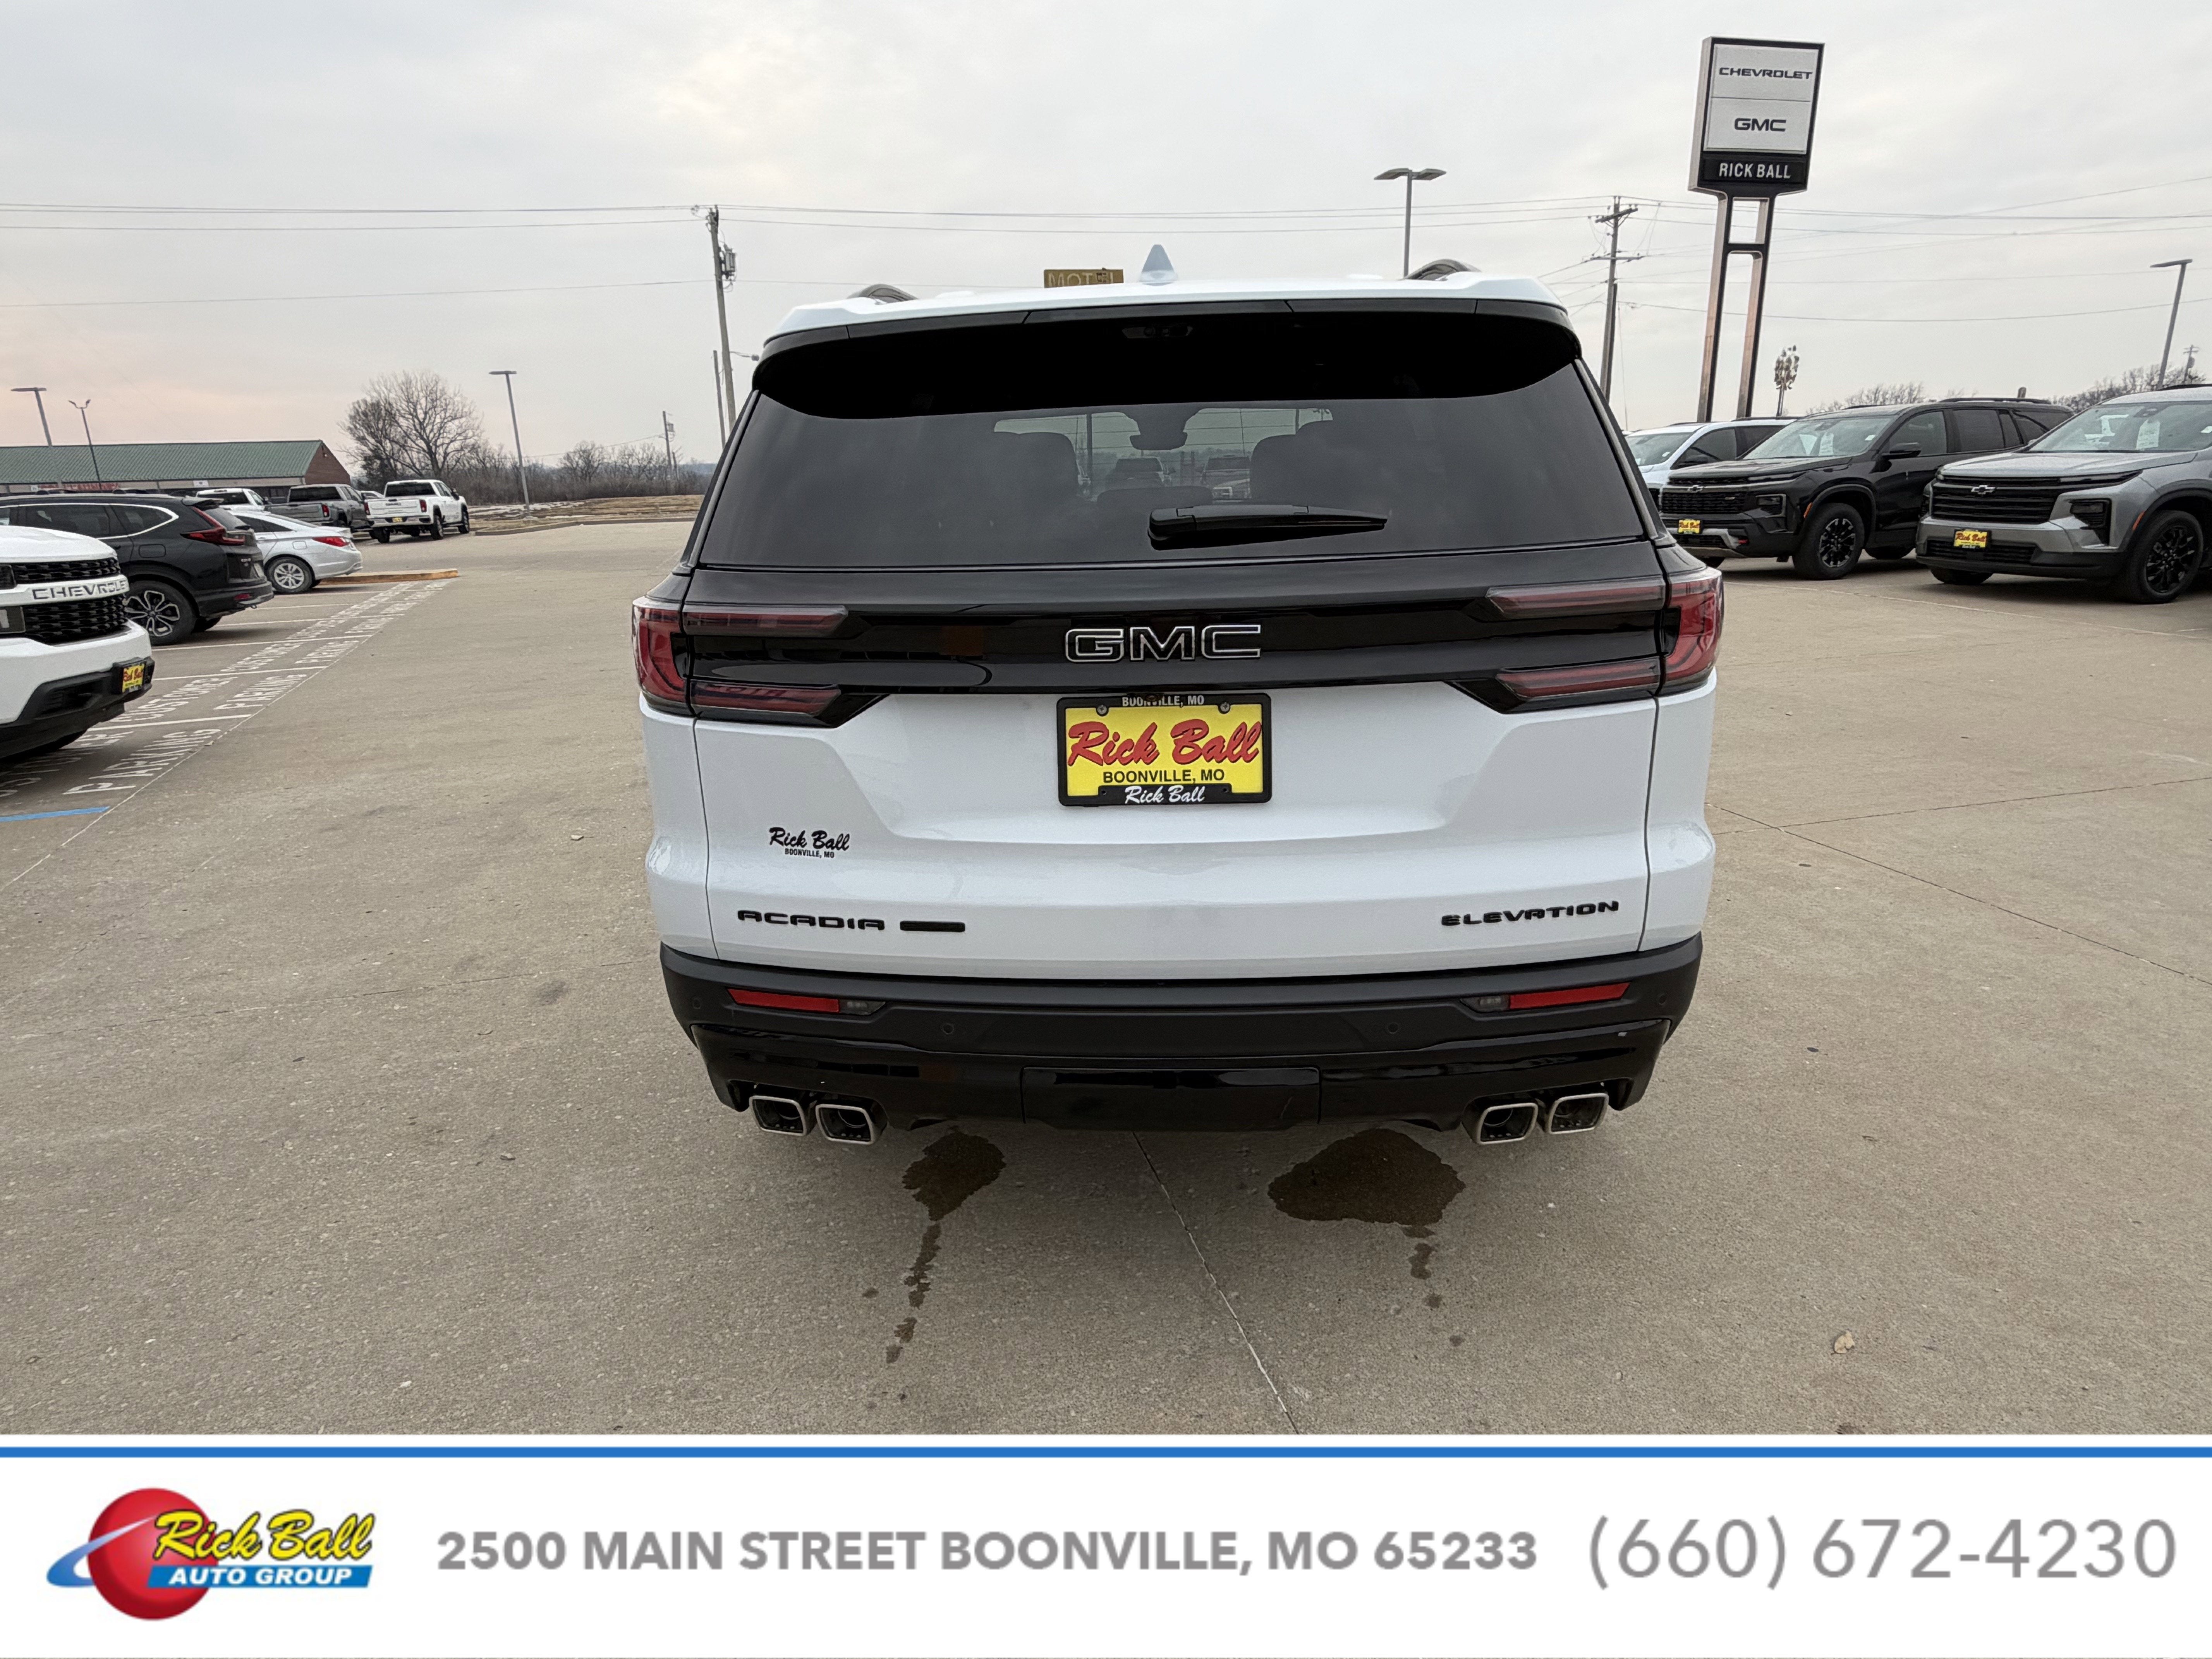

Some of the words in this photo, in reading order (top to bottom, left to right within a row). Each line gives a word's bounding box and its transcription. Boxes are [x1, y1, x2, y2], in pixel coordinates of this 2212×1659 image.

[1719, 67, 1813, 79] CHEVROLET
[1734, 118, 1787, 132] GMC
[1719, 162, 1753, 178] RICK
[1756, 164, 1791, 179] BALL
[32, 579, 127, 599] CHEVROLE
[1065, 624, 1261, 662] GMC
[1187, 695, 1205, 705] MO
[1068, 721, 1160, 766] Rick
[1170, 719, 1262, 765] Ball
[62, 729, 222, 795] PARKING
[1103, 769, 1196, 784] BOONVILLE,
[1200, 769, 1225, 781] MO
[1124, 786, 1164, 804] Rick
[1168, 786, 1206, 803] Ball
[769, 826, 807, 848] Rick
[811, 830, 850, 851] Ball
[785, 848, 822, 859] BOONVILLE,
[737, 910, 885, 930] ACADIA
[1441, 901, 1619, 926] ELEVATION
